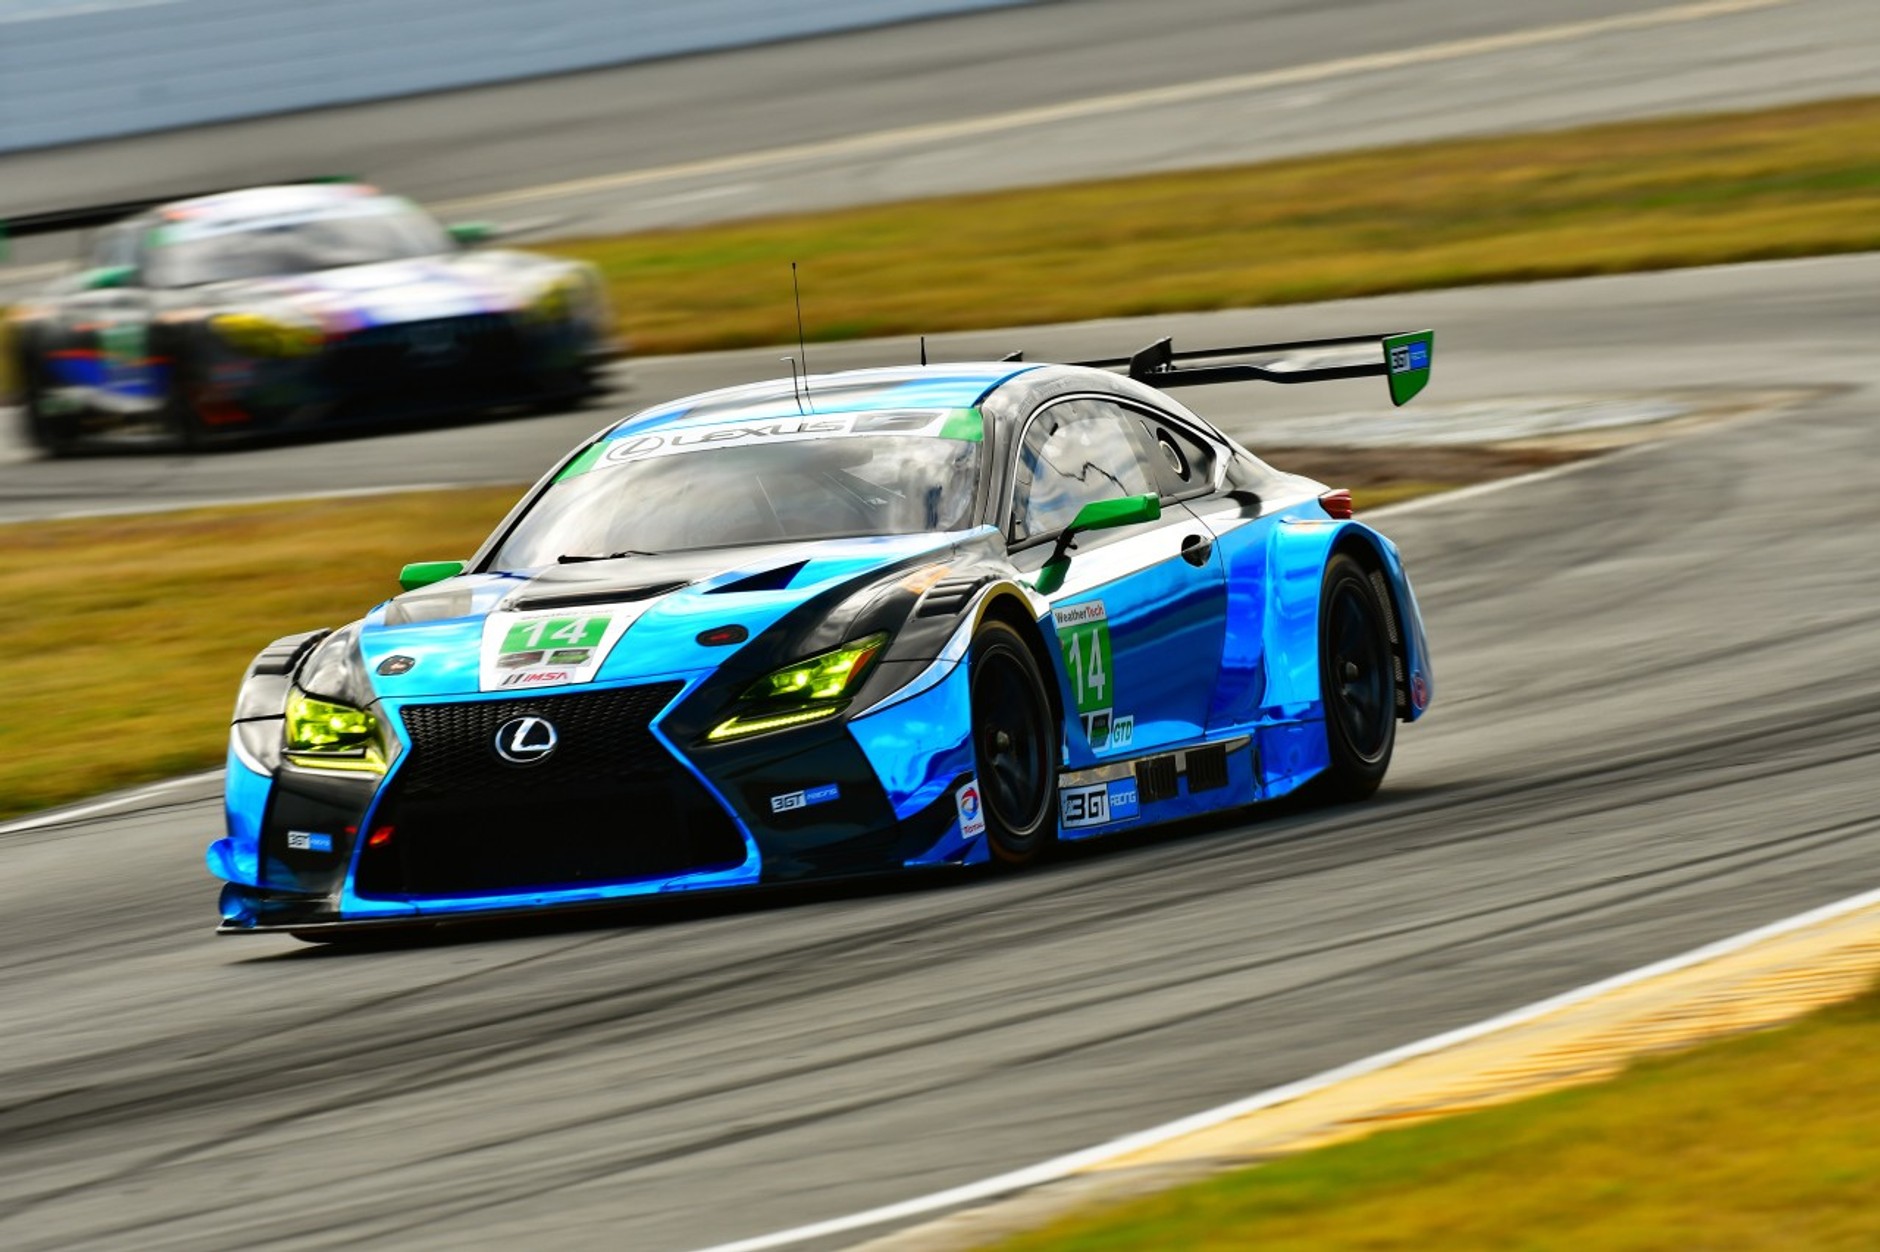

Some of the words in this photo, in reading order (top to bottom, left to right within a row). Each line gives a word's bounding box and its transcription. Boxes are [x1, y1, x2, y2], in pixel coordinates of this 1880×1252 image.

[672, 420, 846, 446] LEXUS
[1055, 604, 1105, 624] WeatherTech
[522, 617, 588, 647] 14
[523, 671, 568, 682] IMSA
[1069, 628, 1106, 705] 14
[1113, 720, 1132, 742] GTD
[1066, 789, 1107, 822] 3GT
